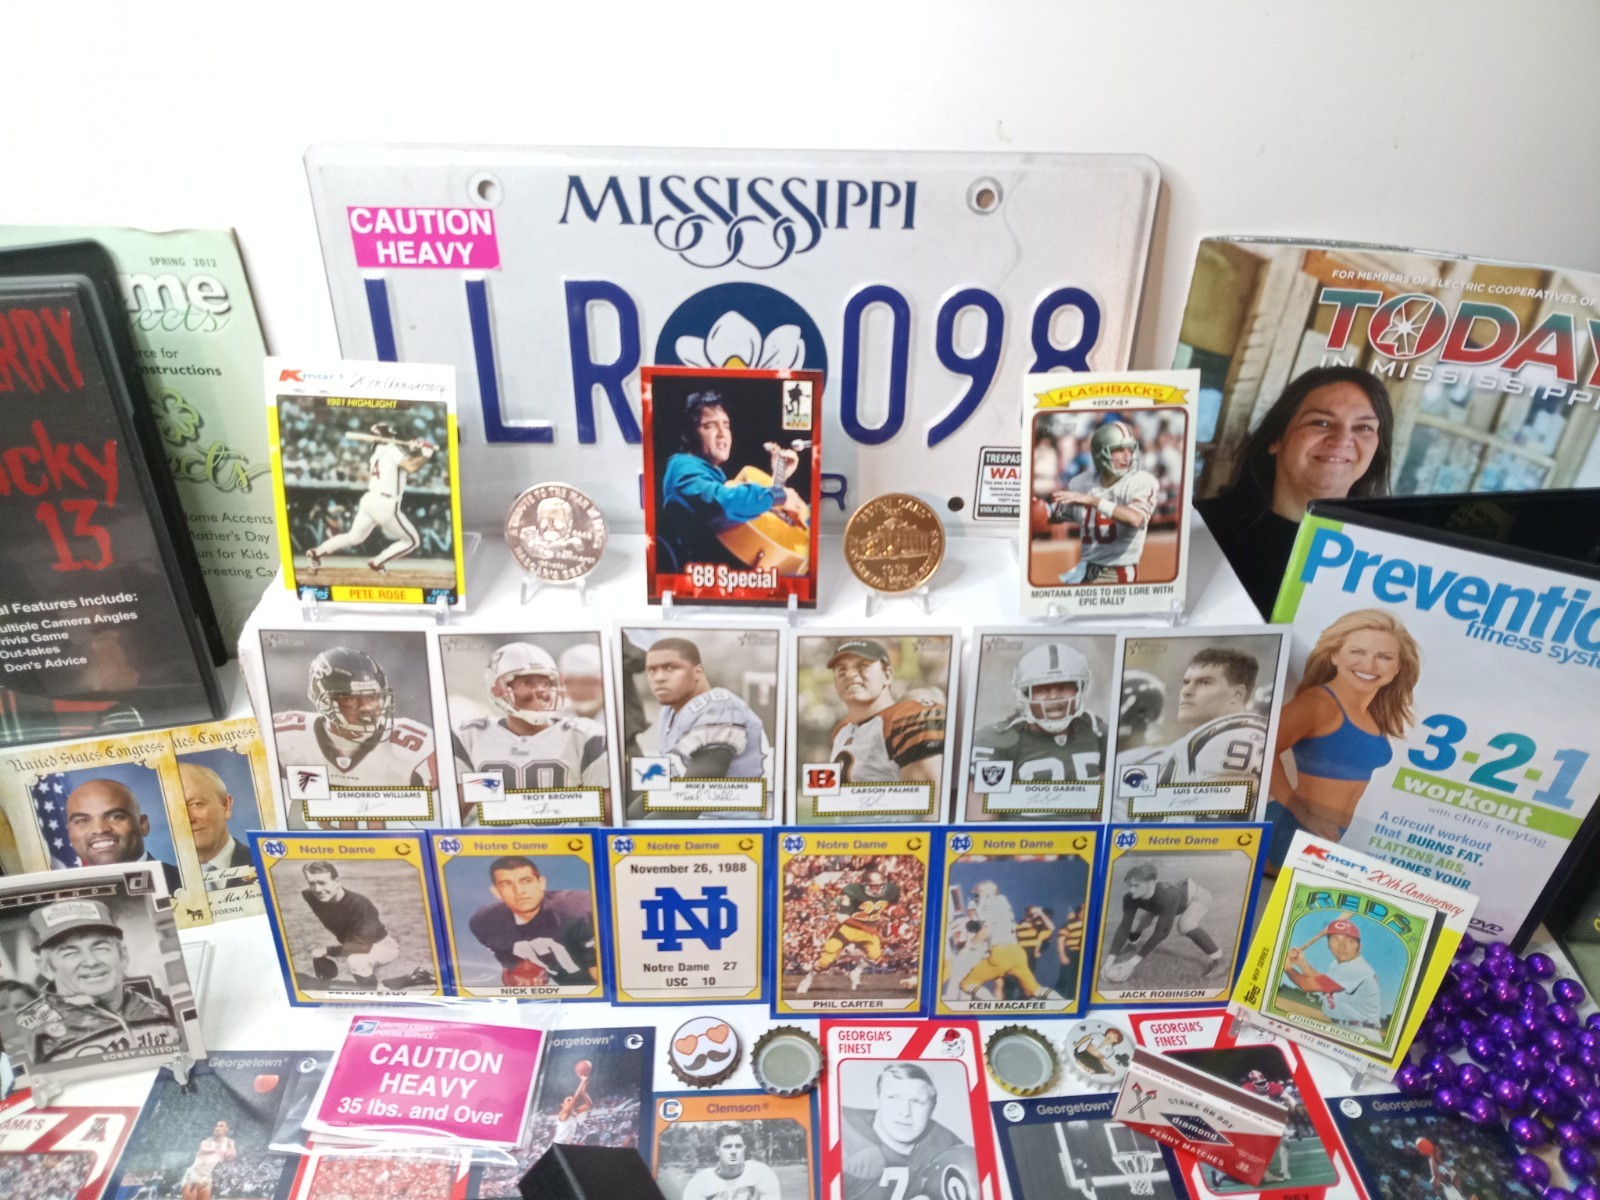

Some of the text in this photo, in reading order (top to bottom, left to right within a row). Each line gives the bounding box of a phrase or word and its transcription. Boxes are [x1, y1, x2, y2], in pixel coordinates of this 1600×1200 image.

[349, 207, 492, 237] CAUTION
[558, 174, 918, 269] MISSISSIPPI
[377, 240, 474, 266] HEAVY
[149, 257, 218, 268] SPRING 2012
[1331, 269, 1355, 281] FOR
[1357, 271, 1410, 285] MEMBERS
[1413, 274, 1429, 286] OF
[1431, 278, 1486, 293] ELECTRIC
[1487, 284, 1577, 306] COOPERATIVES
[161, 347, 179, 358] for
[840, 284, 1101, 448] 098
[1319, 354, 1355, 370] IN
[1059, 383, 1164, 400] FLASHBACKS
[326, 398, 398, 409] 1981 HIGHLIGHT
[0, 419, 118, 508] cky
[990, 467, 1021, 479] WA
[222, 512, 274, 525] Accents
[35, 499, 113, 571] 13
[245, 531, 271, 545] Day
[217, 547, 270, 560] for Kids
[686, 566, 777, 591] '68 Special
[349, 589, 374, 600] PETE
[378, 589, 406, 601] ROSE
[1031, 585, 1174, 599] MONTANA ADDS TO HIS LORE WITH
[12, 592, 139, 614] Features Include:
[1078, 596, 1125, 606] EPIC RALLY
[41, 611, 138, 629] Camera Angles
[31, 632, 69, 643] Game
[1465, 621, 1543, 654] fitness
[0, 645, 61, 659] Out-takes
[4, 655, 88, 673] Don's Advice
[198, 727, 257, 746] Congress
[6, 741, 165, 773] United States Congress
[337, 791, 421, 799] DEMORRIO WILLIAMS
[522, 792, 583, 801] TROY BROWN
[888, 786, 920, 794] PALMER
[1193, 787, 1231, 795] CASTILLO
[1402, 774, 1534, 826] workout
[1379, 810, 1493, 852] A circuit workout
[1428, 806, 1548, 849] with chris freytag
[473, 841, 549, 851] Notre Dame
[647, 841, 720, 850] Notre Dame
[816, 840, 888, 849] Notre Dame
[983, 839, 1054, 849] Notre Dame
[1147, 835, 1219, 845] Notre Dame
[1374, 825, 1484, 868] that BURNS FAT,
[299, 844, 375, 855] Notre Dame
[1368, 836, 1467, 876] FLATTENS ABS,
[630, 862, 748, 876] November 26, 1988
[1389, 855, 1472, 891] TONES YOUR
[1301, 844, 1465, 919] Kmart 20th Anniversary
[1307, 891, 1412, 934] REDS
[643, 961, 738, 973] Notre Dame 27
[1252, 946, 1270, 981] MVP SERIES
[665, 976, 716, 987] USC 10
[501, 987, 560, 995] NICK EDDY
[1118, 989, 1206, 999] JACK ROBINSON
[812, 1000, 884, 1009] PHIL CARTER
[968, 1001, 1047, 1010] KEN MACAFEE
[1150, 1022, 1203, 1035] GEORGIA'S
[1292, 1014, 1361, 1042] JOHNNY BENCH
[838, 1030, 892, 1042] GEORGIA'S
[1155, 1034, 1188, 1047] FINEST
[102, 1045, 181, 1062] BOBBY ALLISON
[838, 1043, 872, 1055] FINEST
[208, 1056, 284, 1069] Georgetown
[369, 1042, 503, 1075] CAUTION
[378, 1072, 477, 1100] HEAVY
[337, 1096, 504, 1126] 35 lbs. and Over
[706, 1103, 761, 1115] Clemson
[1036, 1101, 1110, 1116] Georgetown
[1167, 1097, 1200, 1110] STRIKE
[1203, 1107, 1216, 1118] ON
[1216, 1114, 1235, 1129] BOX
[1171, 1116, 1218, 1142] diamond
[1149, 1128, 1180, 1146] PENNY
[1182, 1143, 1225, 1167] MATCHES
